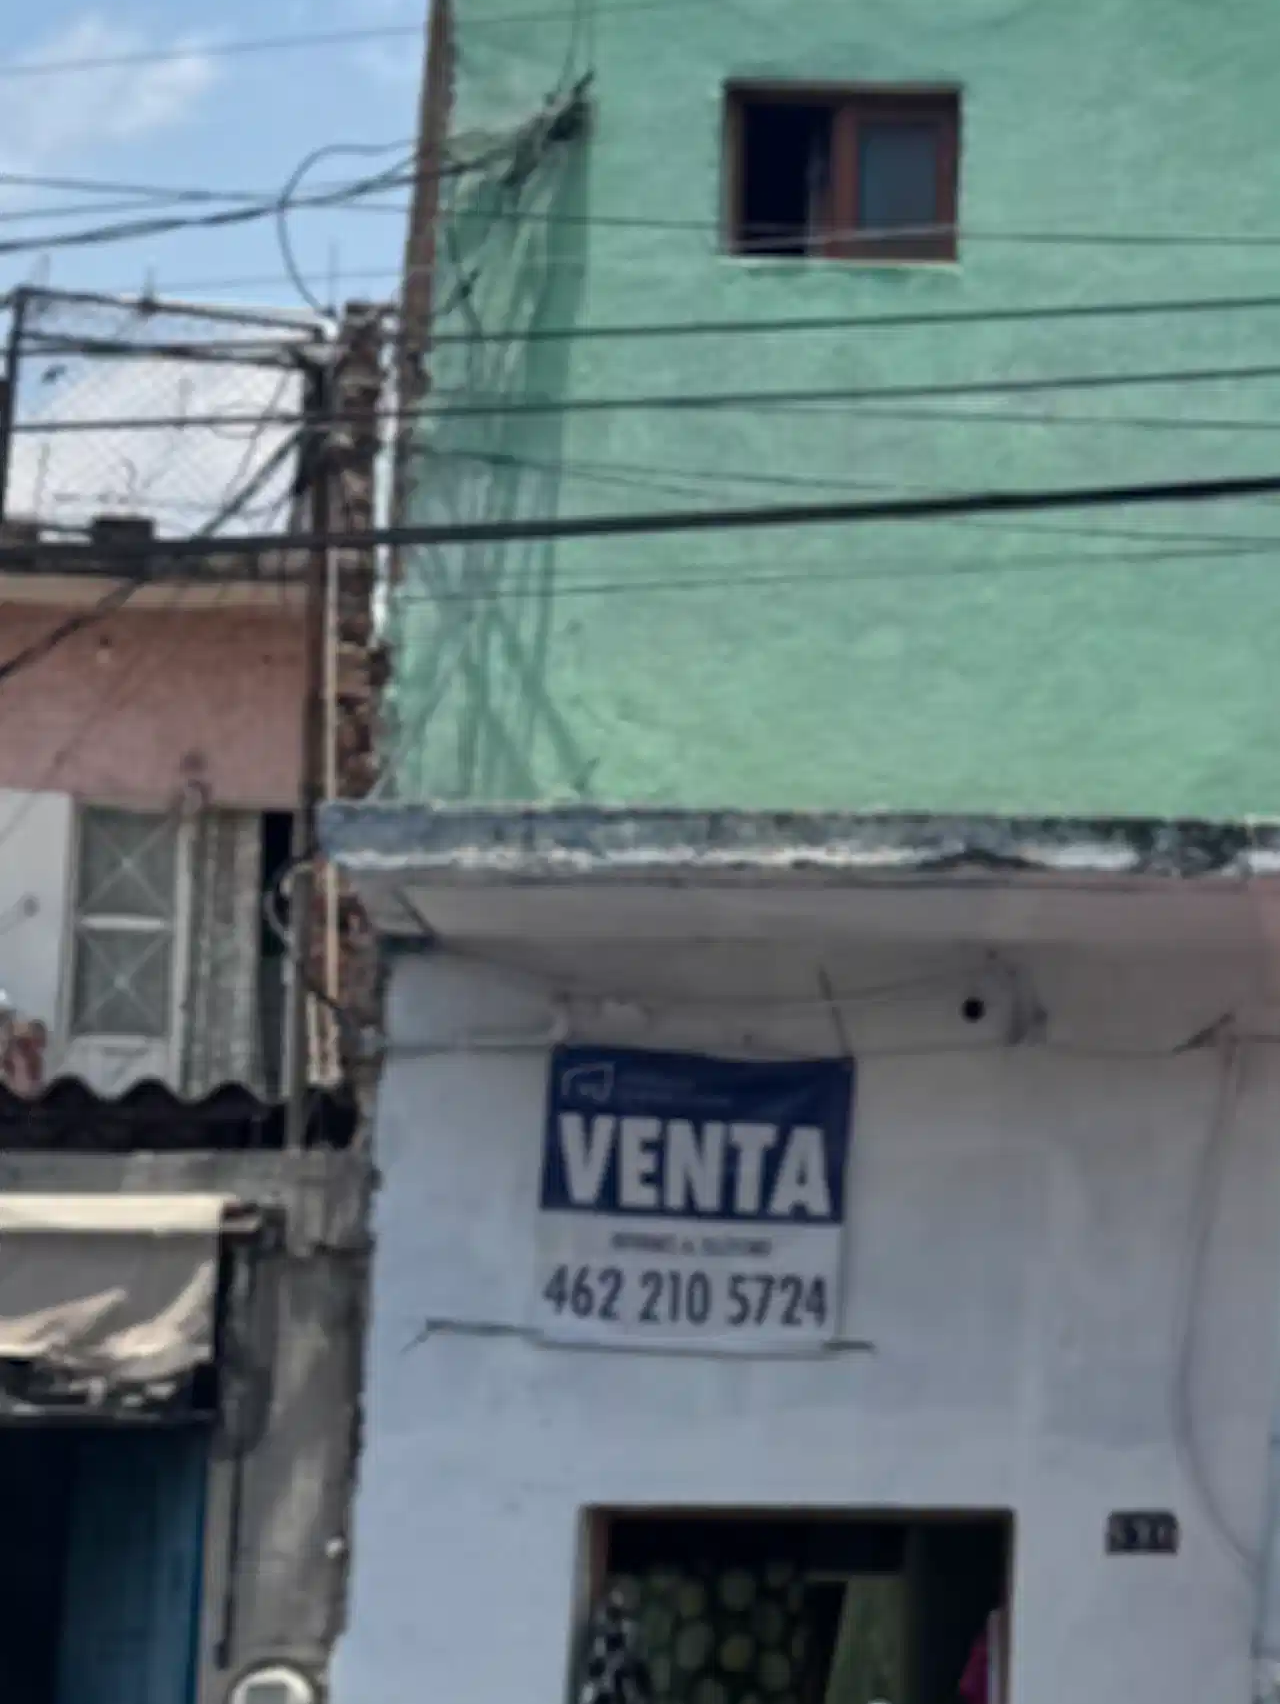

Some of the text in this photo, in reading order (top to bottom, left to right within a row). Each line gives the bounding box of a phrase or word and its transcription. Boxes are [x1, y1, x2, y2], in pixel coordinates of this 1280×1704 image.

[557, 1112, 833, 1217] VENTA
[541, 1264, 828, 1329] 462 210 5724
